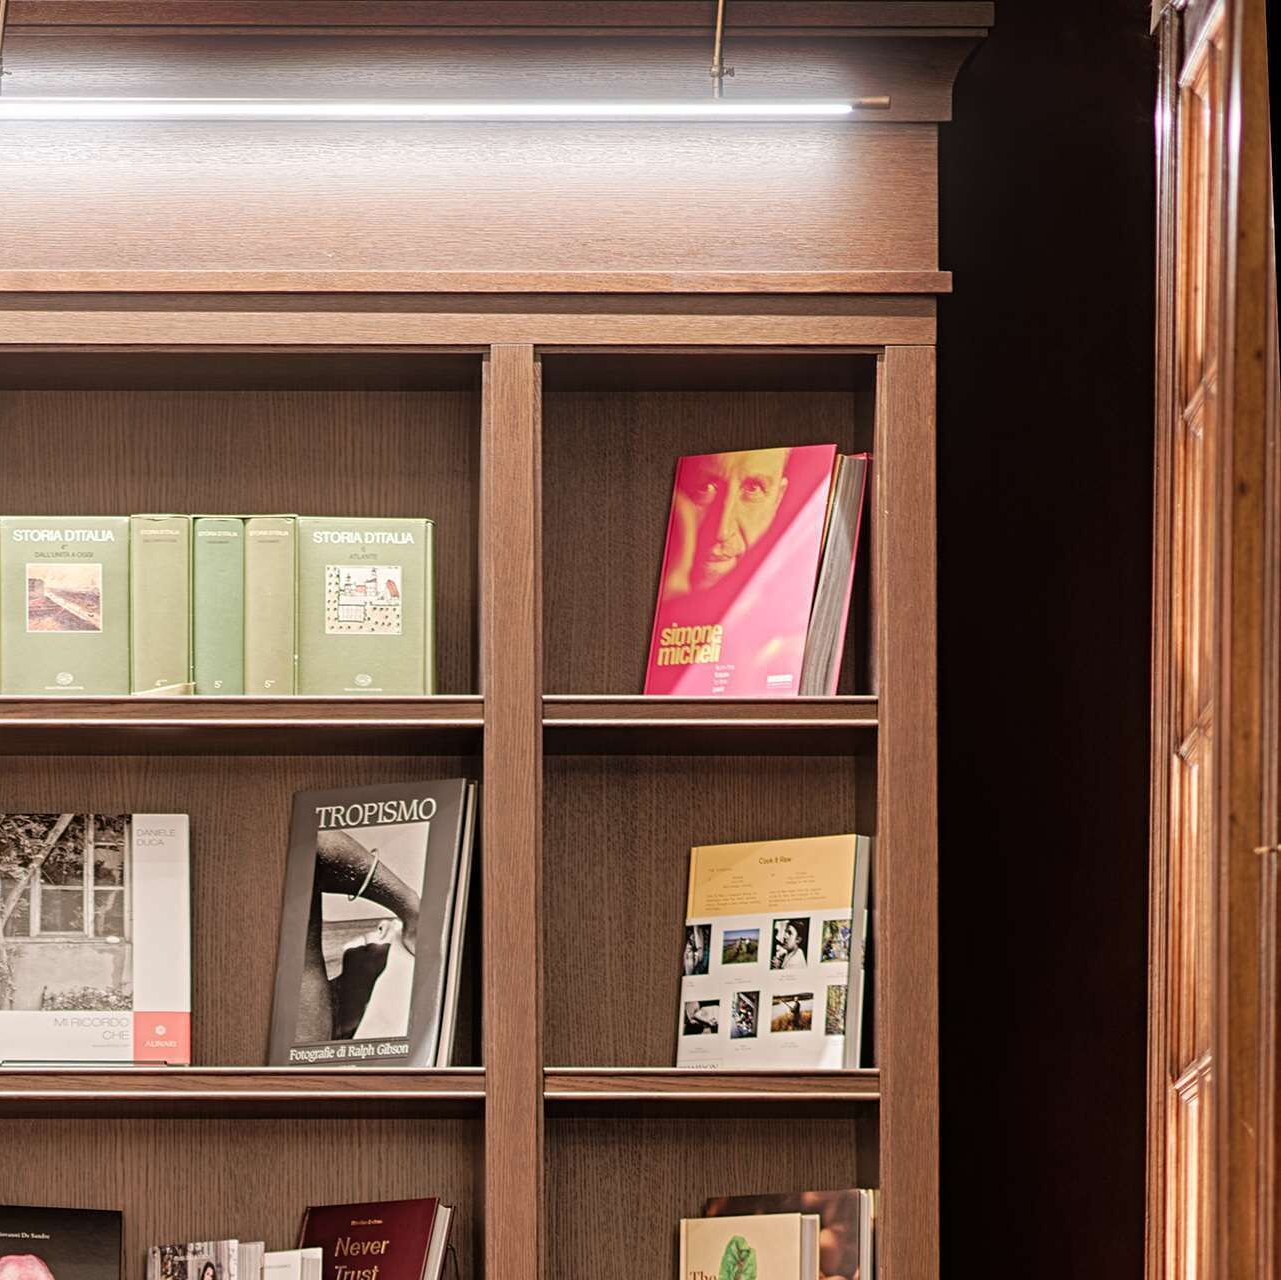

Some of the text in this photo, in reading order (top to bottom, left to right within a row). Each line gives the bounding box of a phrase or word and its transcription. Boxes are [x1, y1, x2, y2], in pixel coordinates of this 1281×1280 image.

[13, 529, 115, 543] STORIA D'ITALIA
[312, 530, 415, 544] STORIA D'ITALIA
[661, 623, 723, 646] simone
[657, 641, 721, 666] micheli
[316, 798, 437, 828] TROPISMO
[71, 1018, 130, 1029] RICORDO
[102, 1030, 130, 1041] CHE
[289, 1042, 409, 1062] Fotografie di Ralph Gibson
[334, 1236, 390, 1258] Never
